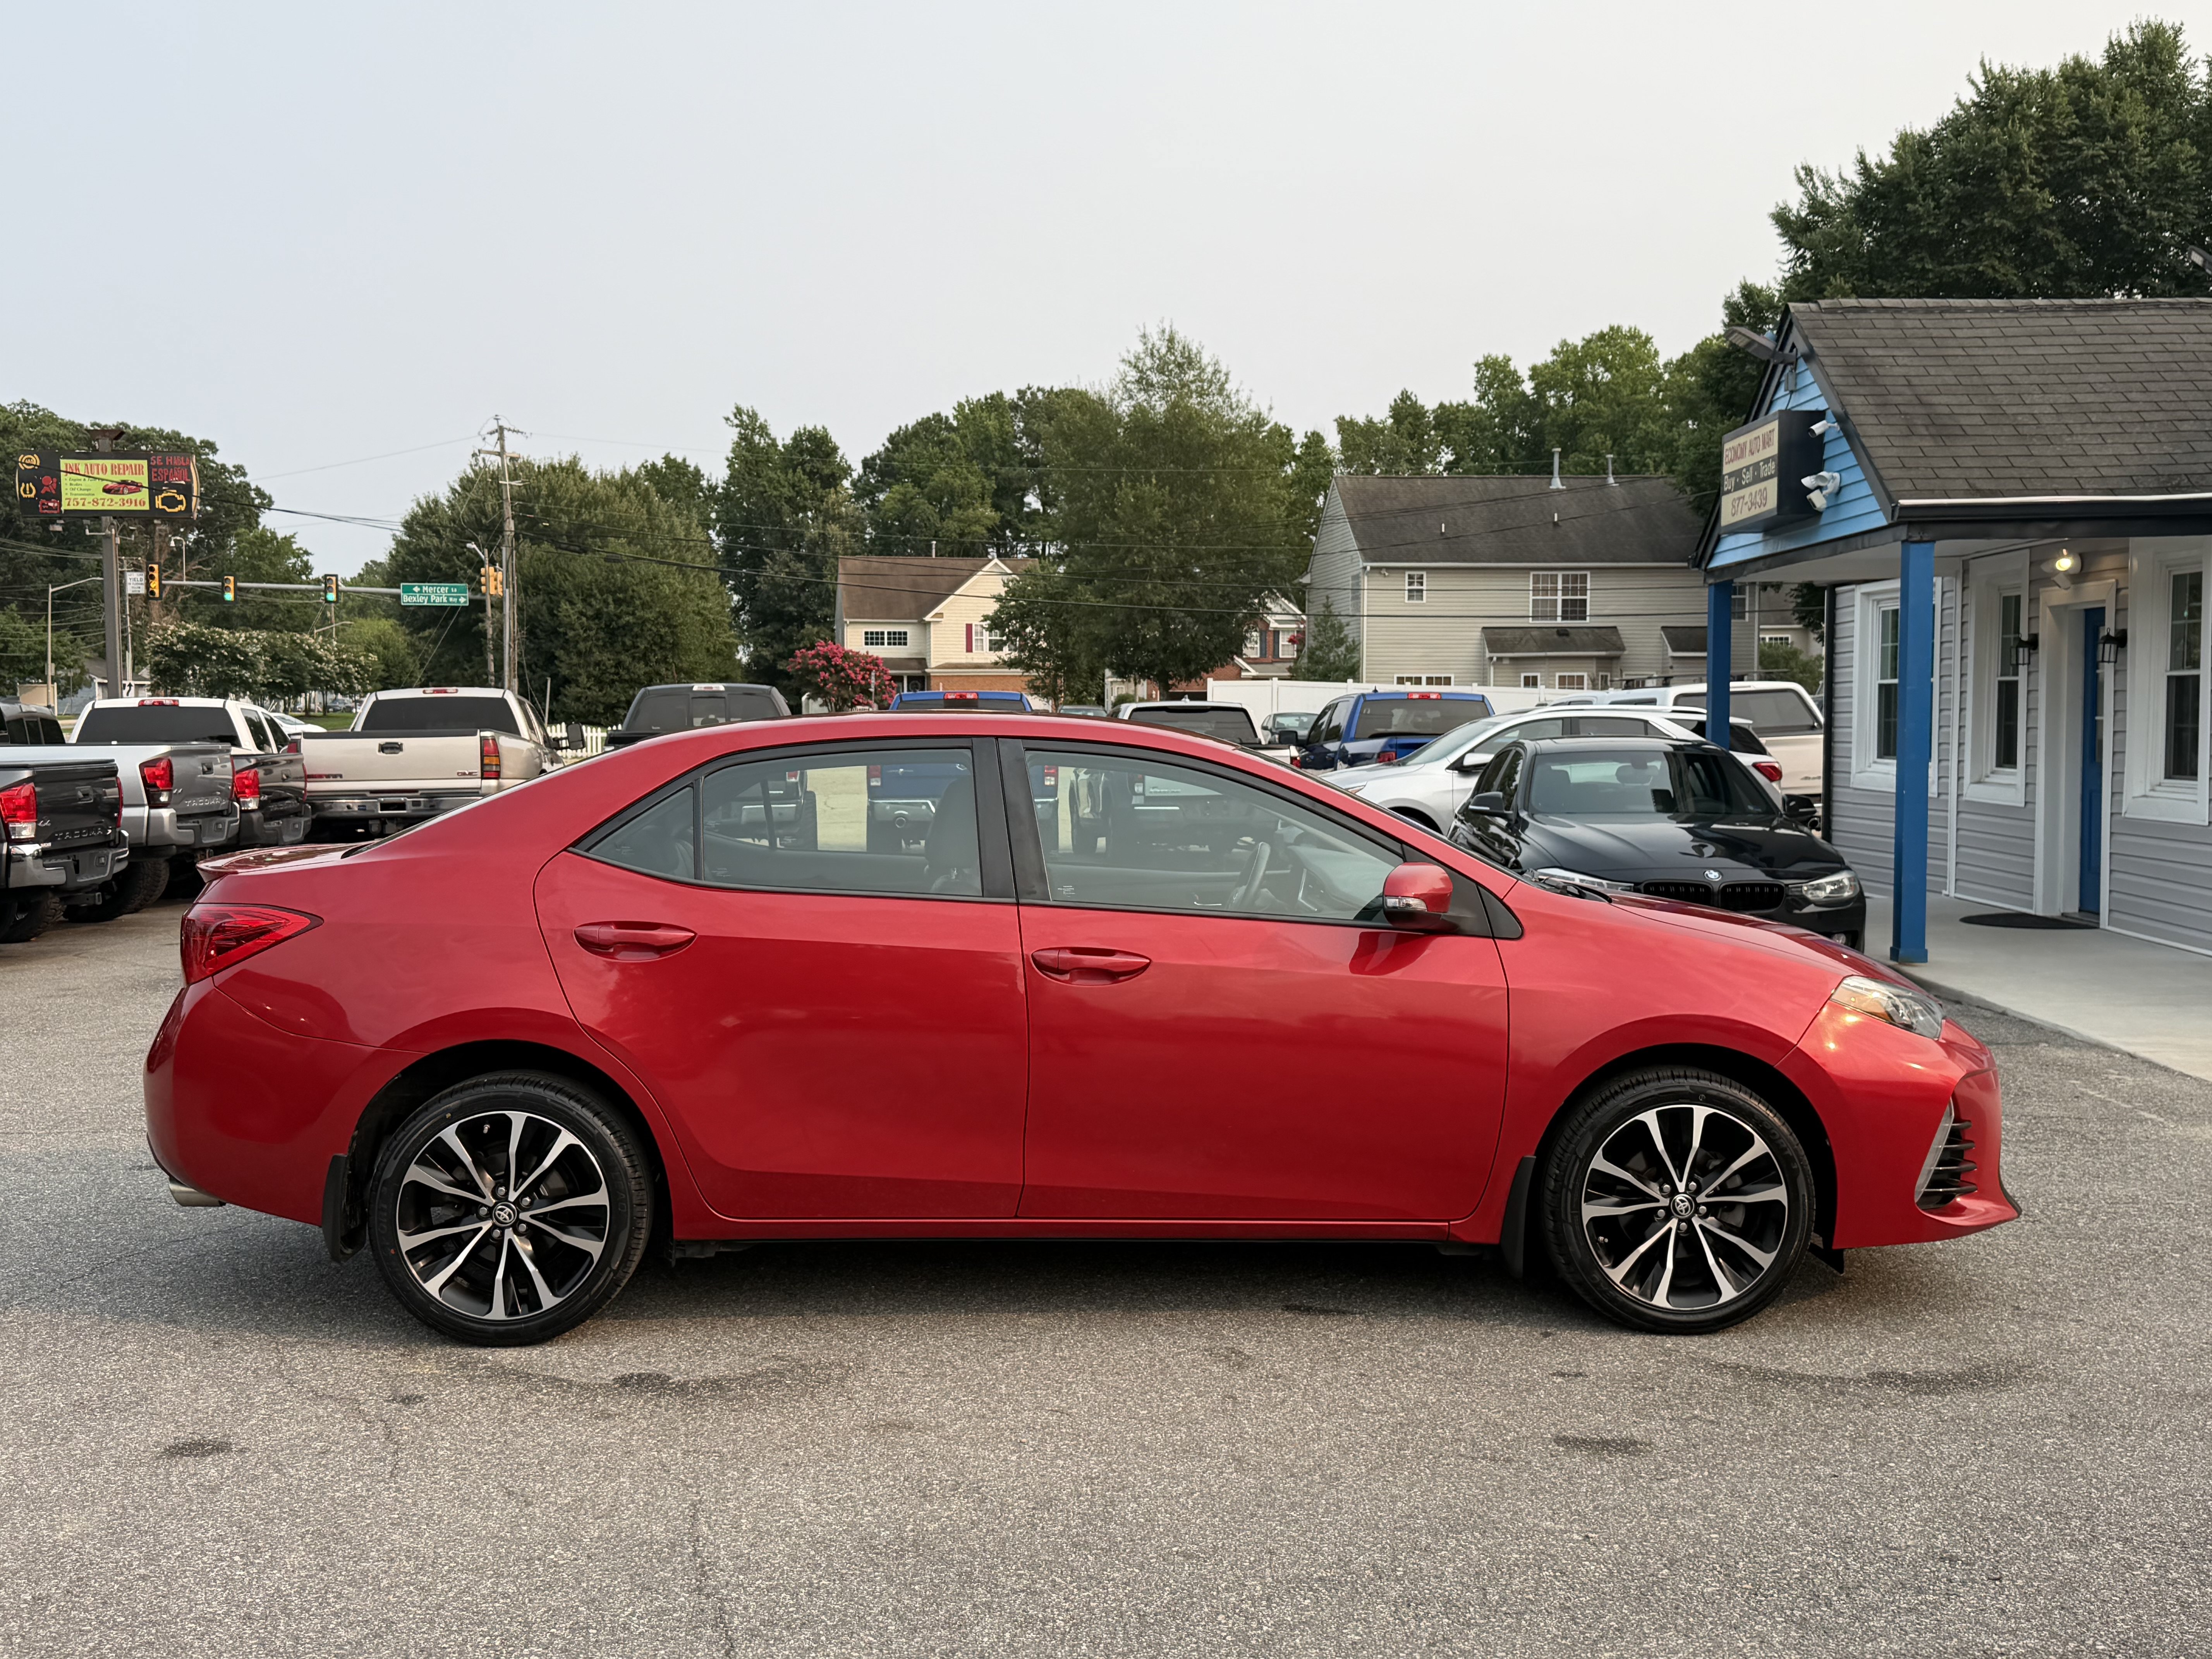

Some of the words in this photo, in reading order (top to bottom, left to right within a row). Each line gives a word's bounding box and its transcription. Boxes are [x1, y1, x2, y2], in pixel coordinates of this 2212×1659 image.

[1725, 441, 1747, 464] ECONOMY
[1749, 436, 1760, 455] AUTO
[1762, 428, 1775, 450] MART
[150, 456, 163, 466] SE
[84, 463, 108, 476] AUTO
[110, 463, 144, 476] REPAIR
[152, 467, 191, 481] ESPAÑOL
[1724, 474, 1735, 491] Buy
[1742, 465, 1753, 485] Sell
[1759, 459, 1775, 478] Trade
[65, 498, 146, 507] 757-872-3916
[1731, 487, 1767, 517] 877-3439
[403, 595, 428, 604] Bexley
[431, 595, 447, 603] Park
[184, 798, 220, 807] TACOMA
[55, 828, 103, 840] TACOMA
